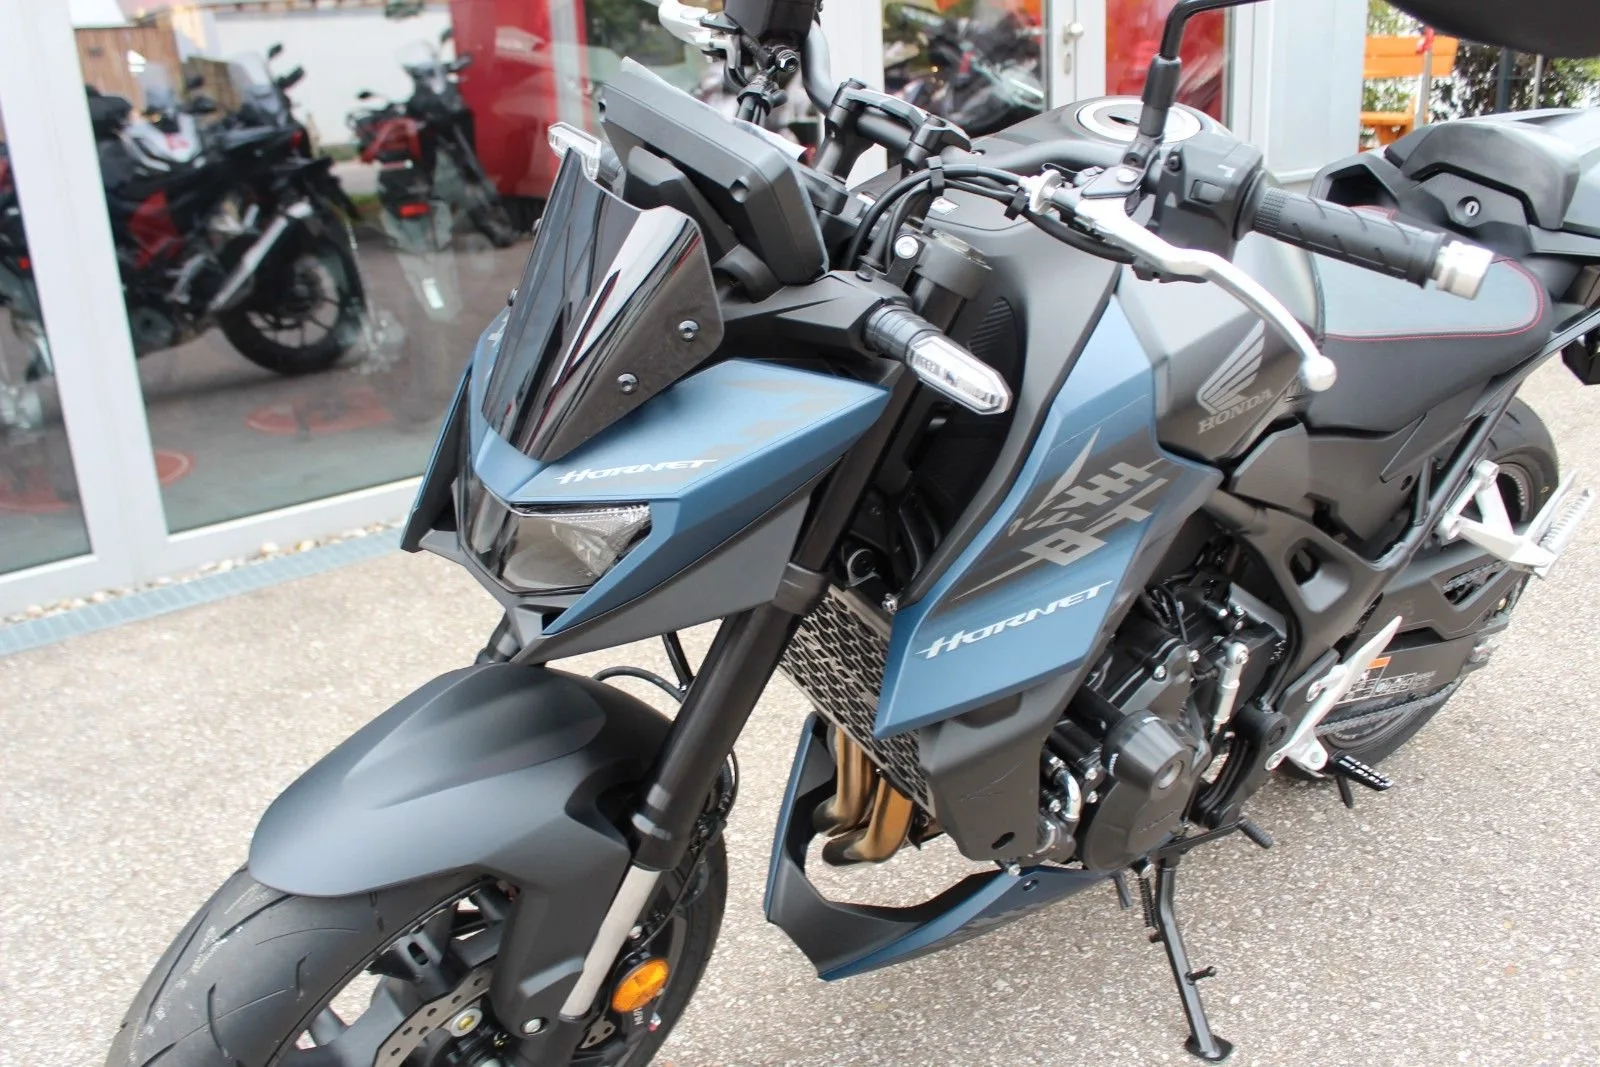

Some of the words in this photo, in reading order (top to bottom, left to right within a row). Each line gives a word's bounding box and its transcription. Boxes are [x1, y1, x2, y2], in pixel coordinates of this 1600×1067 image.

[1198, 389, 1274, 434] HONDA
[554, 459, 718, 484] HORNET
[914, 580, 1114, 660] HORNET
